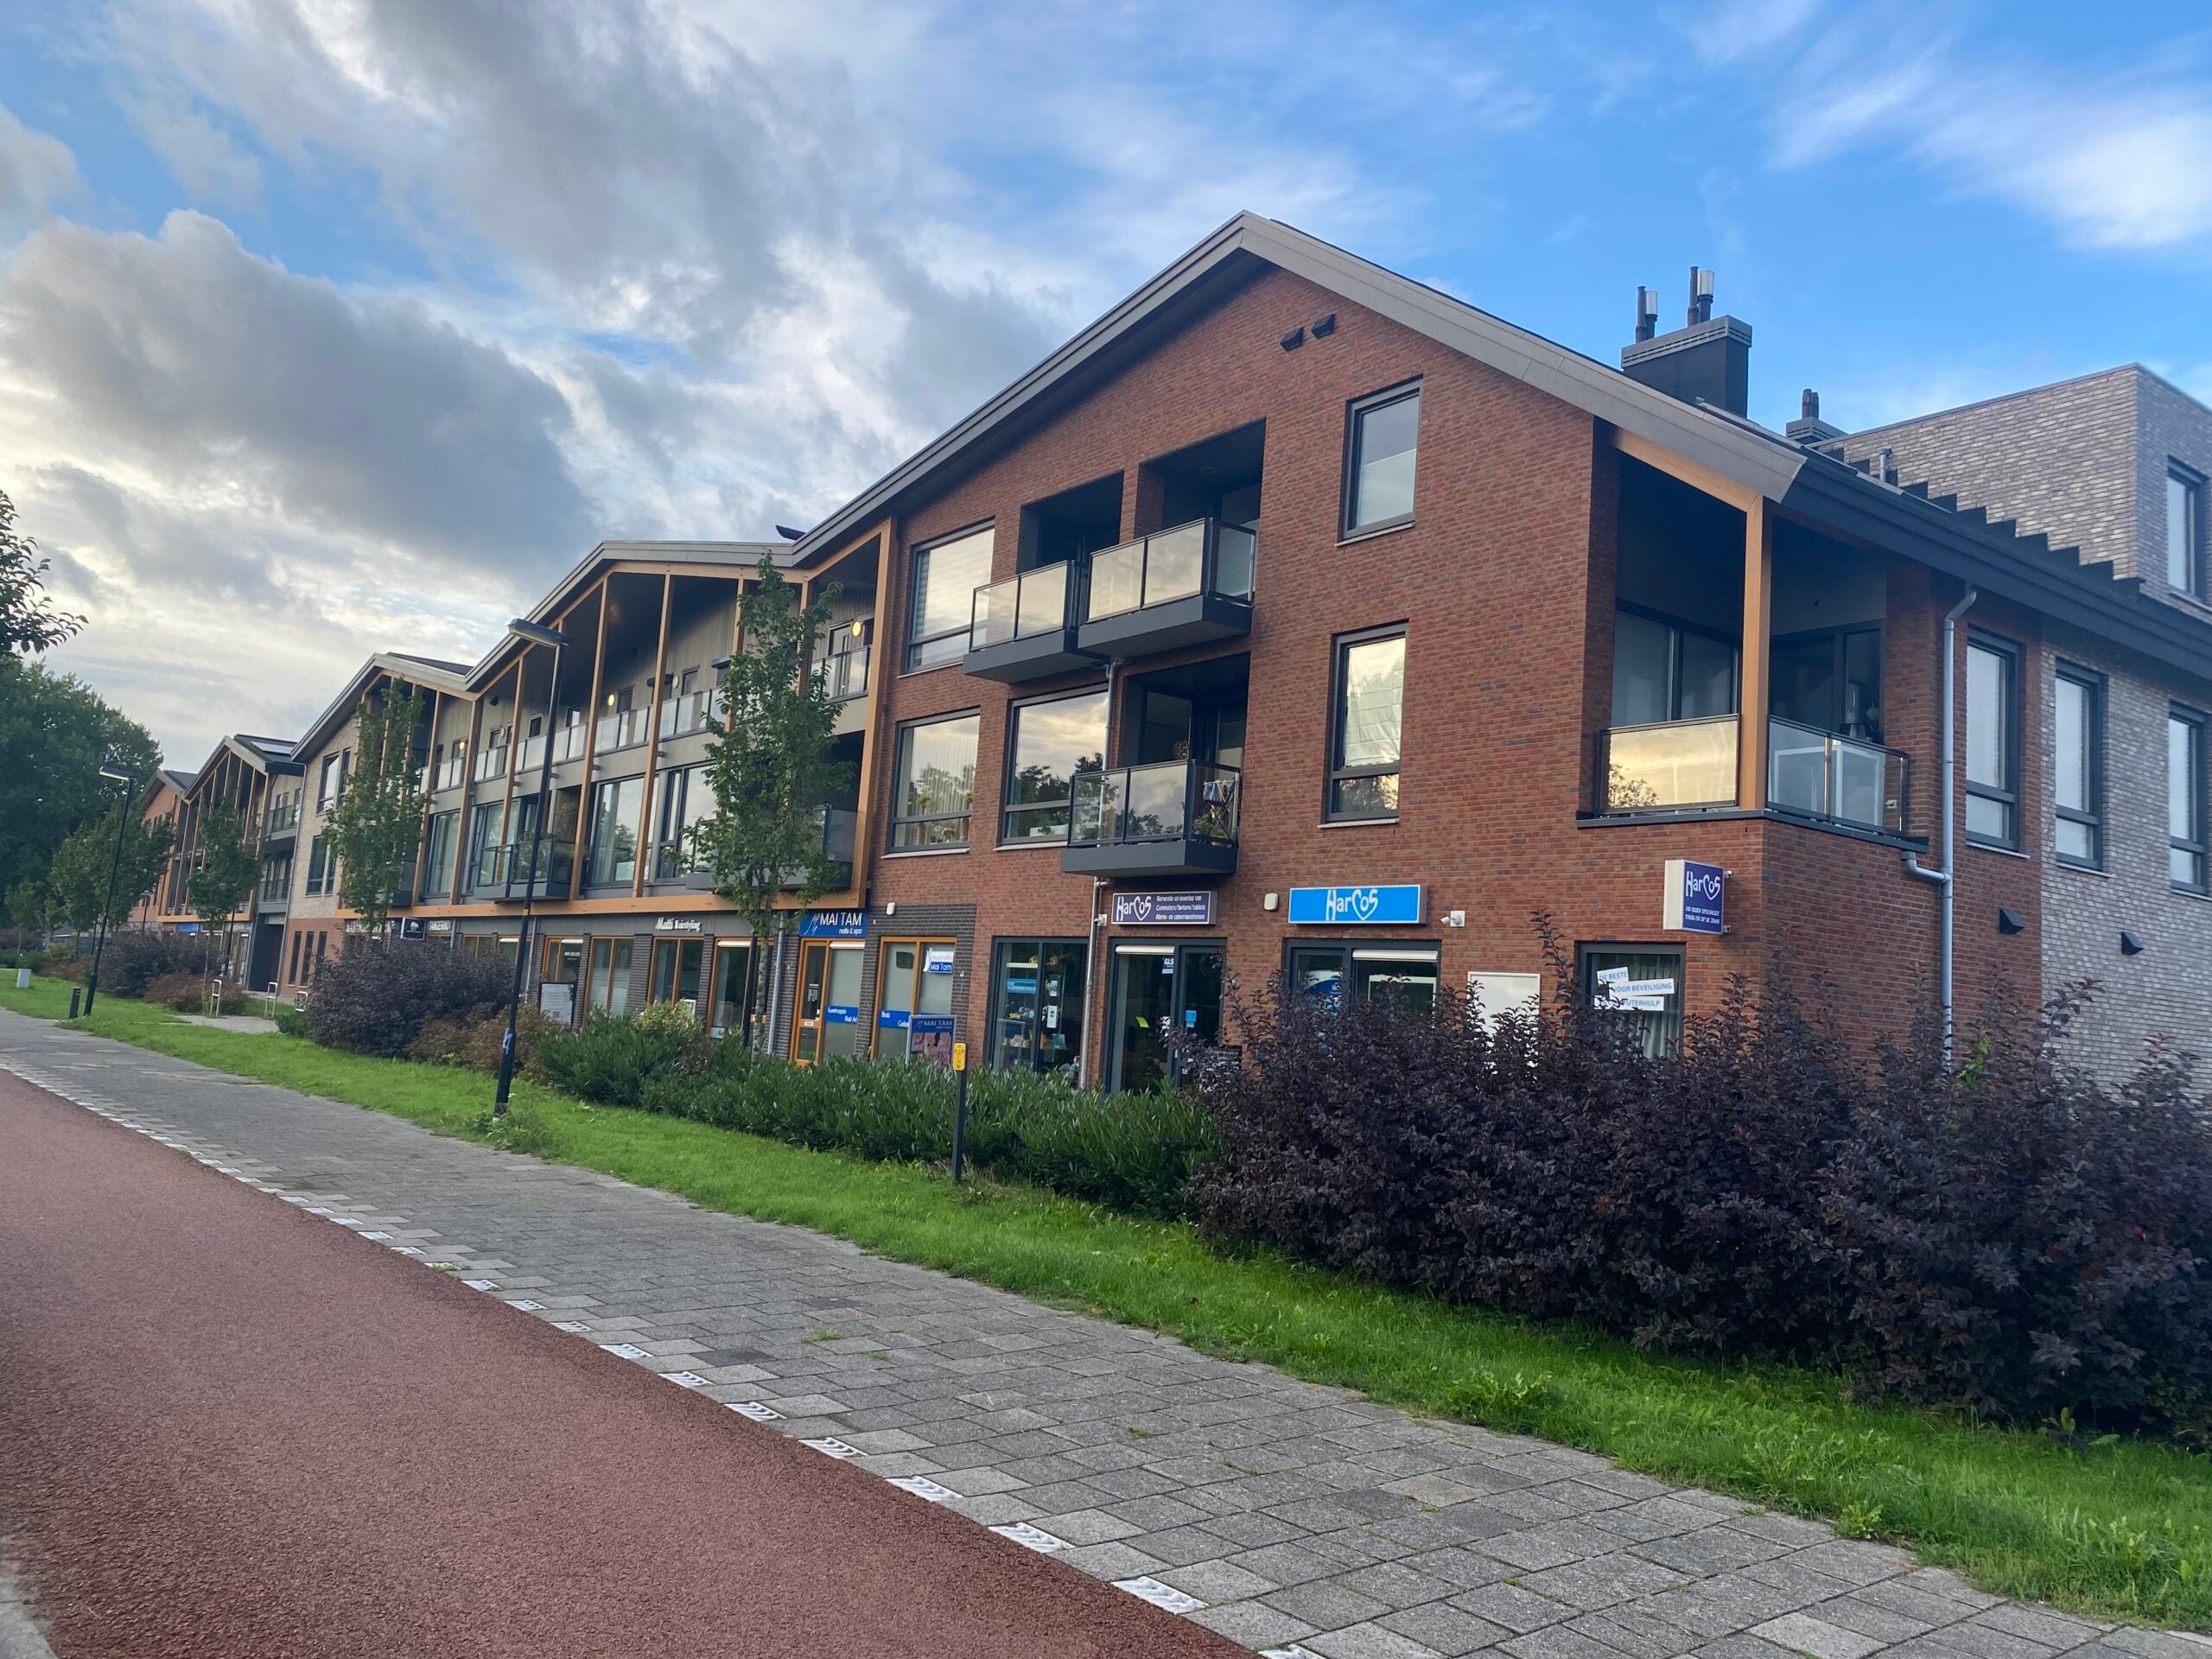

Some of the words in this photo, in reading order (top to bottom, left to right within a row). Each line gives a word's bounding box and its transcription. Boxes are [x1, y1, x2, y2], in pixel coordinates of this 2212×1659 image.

[1685, 870, 1720, 900] HarCos
[1116, 895, 1152, 922] HarCos
[1325, 889, 1379, 921] HarCos
[820, 912, 839, 926] MAI
[841, 912, 862, 926] TAM
[1608, 972, 1627, 981] BESTE
[1631, 982, 1673, 991] BEVEILIGING
